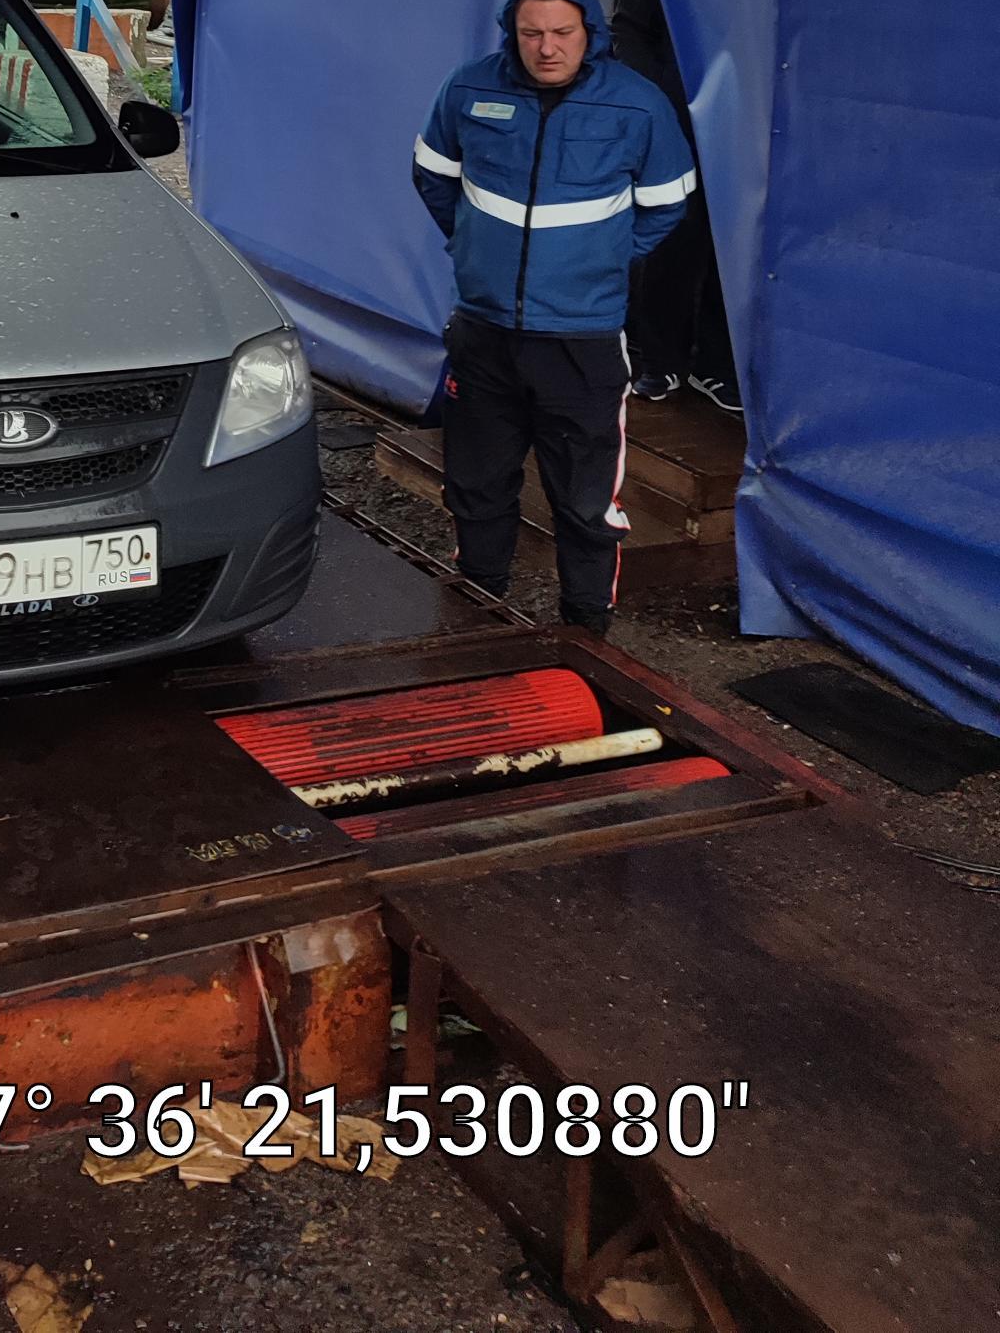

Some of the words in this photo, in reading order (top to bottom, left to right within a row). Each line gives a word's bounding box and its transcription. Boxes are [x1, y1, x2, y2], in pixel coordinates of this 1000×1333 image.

[86, 534, 144, 573] 750
[98, 570, 129, 586] RUS
[0, 600, 53, 616] LADA
